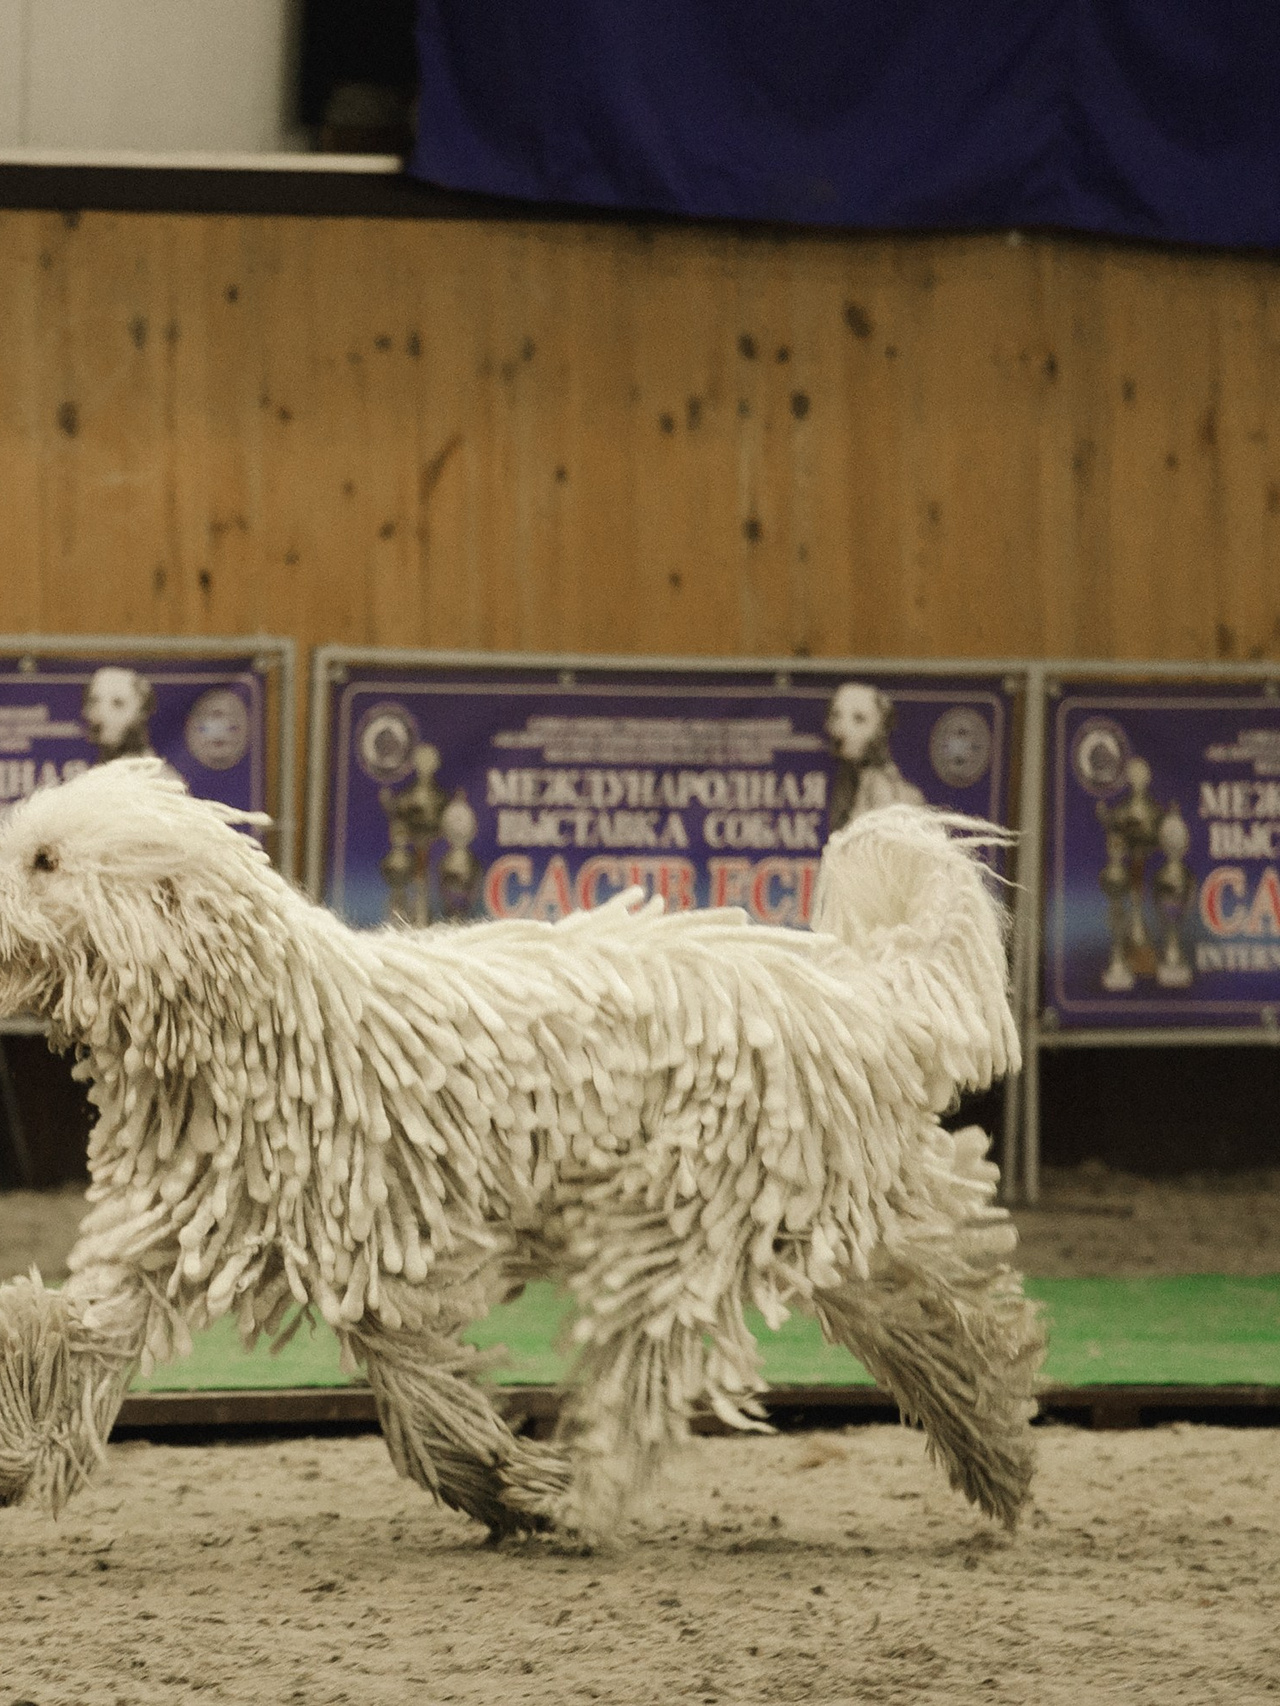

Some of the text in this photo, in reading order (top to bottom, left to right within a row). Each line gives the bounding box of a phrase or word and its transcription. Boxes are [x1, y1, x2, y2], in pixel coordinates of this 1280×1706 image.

[487, 768, 826, 809] МЕЖДУНАРОДНАЯ
[498, 809, 819, 849] ВЫСТАВКА СОБАК
[484, 855, 820, 926] CACIB FCI
